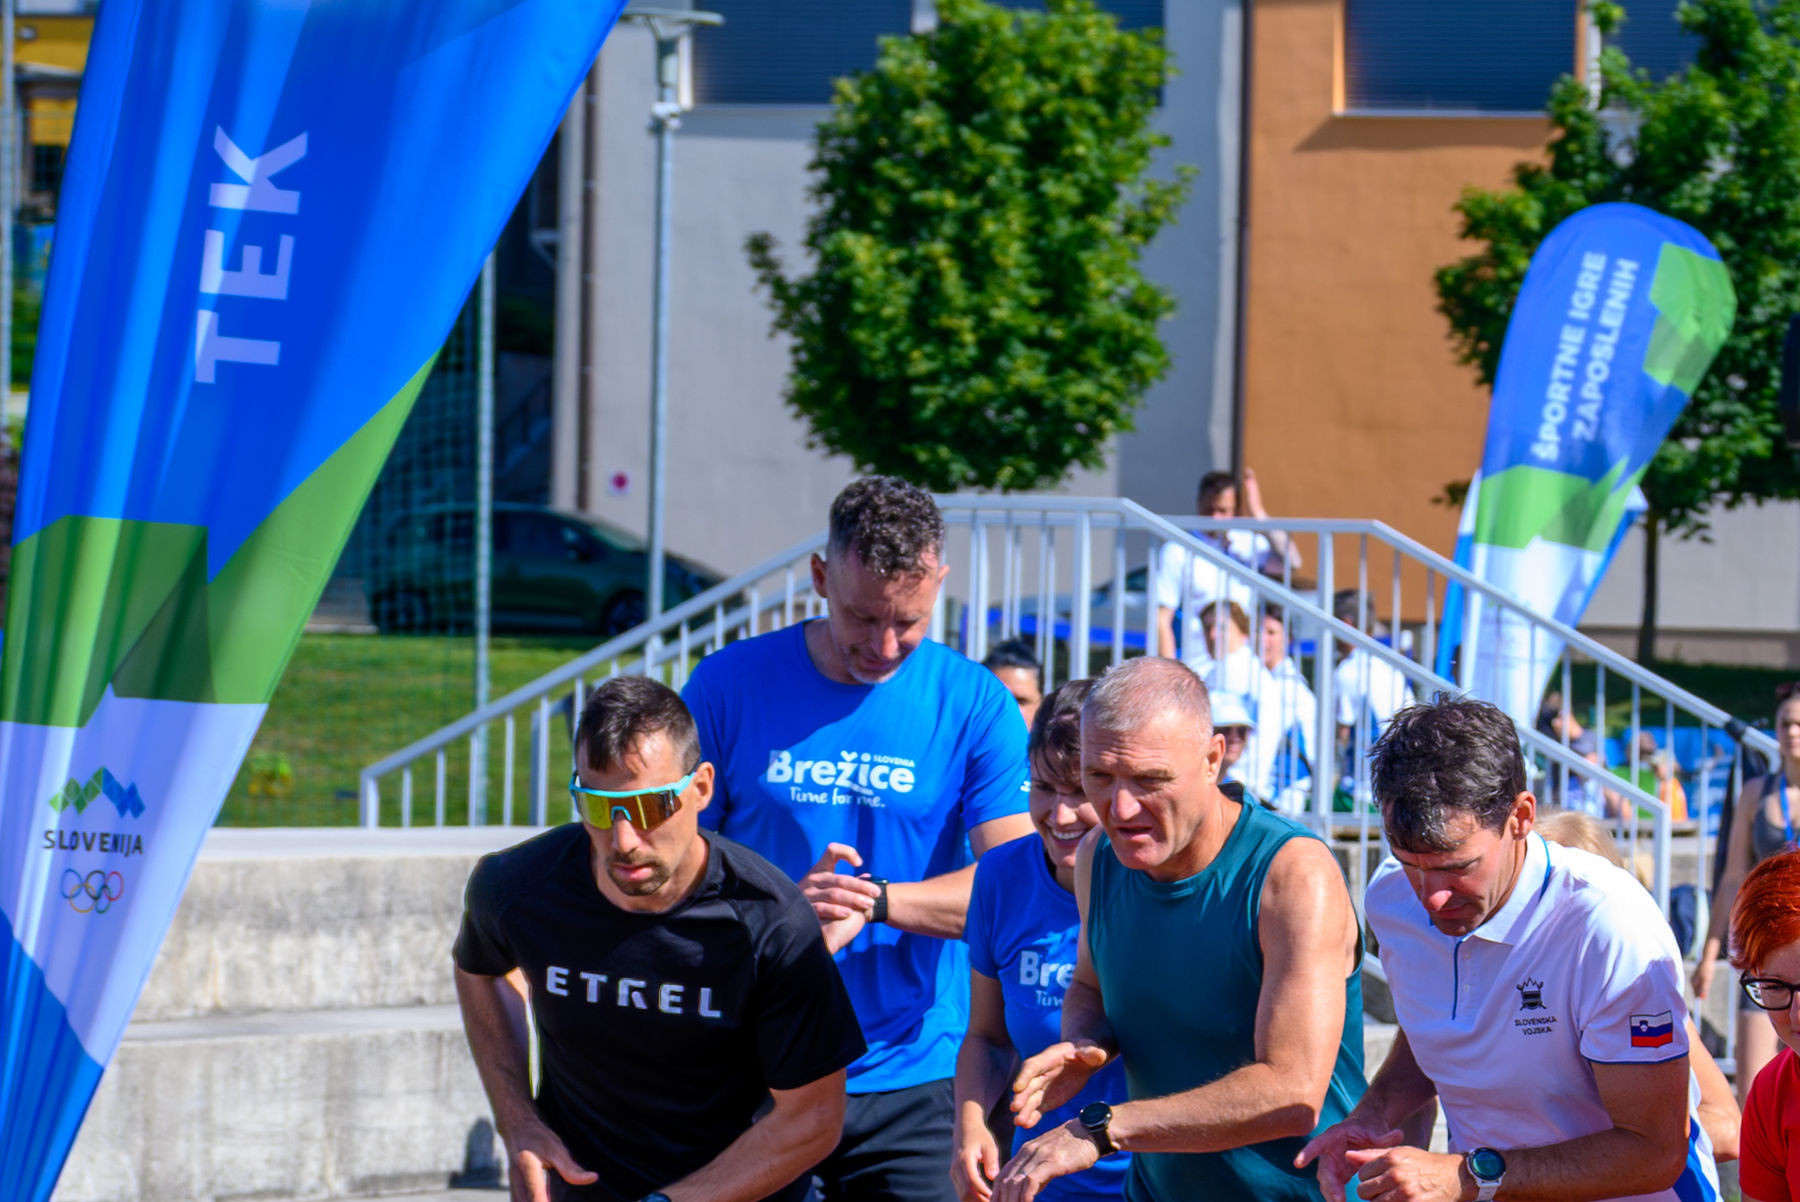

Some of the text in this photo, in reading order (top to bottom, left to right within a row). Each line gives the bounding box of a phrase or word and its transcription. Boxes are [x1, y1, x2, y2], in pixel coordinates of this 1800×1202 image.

[194, 125, 309, 384] TEK
[1530, 251, 1607, 462] ŠPORTNE IGRE
[1571, 257, 1639, 442] ZAPOSLENIH
[767, 750, 915, 794] Brežice
[790, 786, 828, 804] Time
[831, 787, 854, 806] for
[43, 829, 144, 858] SLOVENIJA
[1020, 950, 1076, 989] Bre
[546, 965, 723, 1018] ETREL
[1514, 1015, 1557, 1026] SLOVENSKA
[1522, 1026, 1553, 1036] VOJSKA
